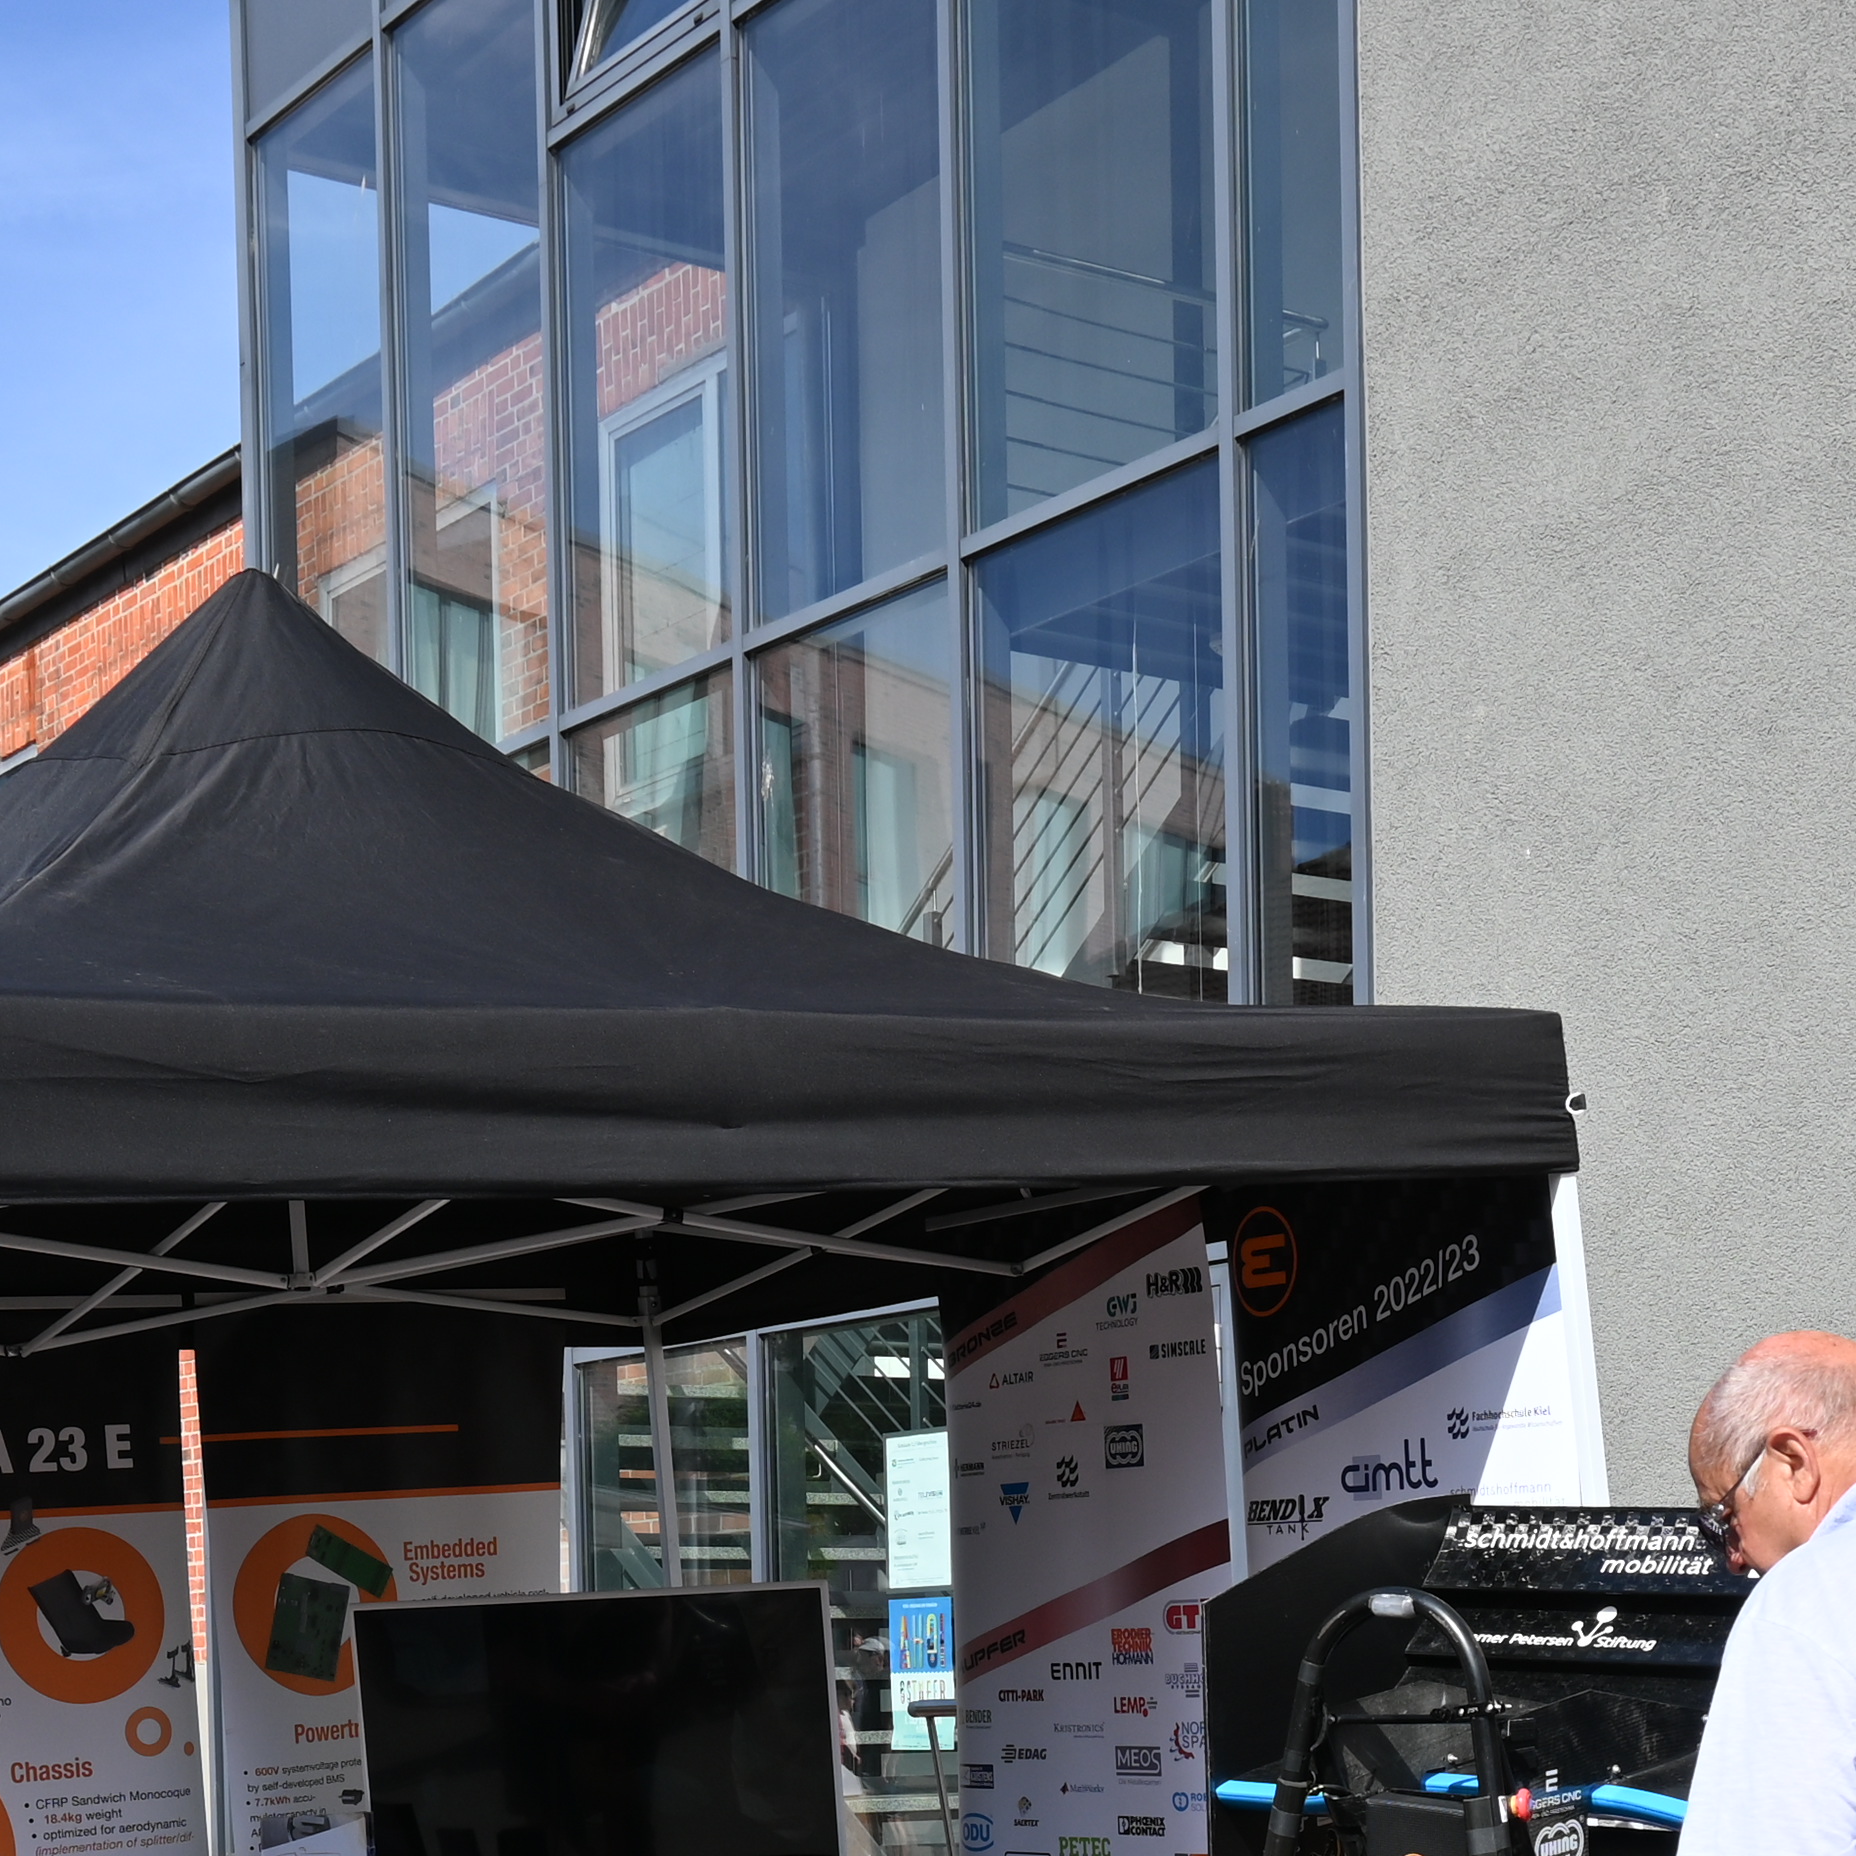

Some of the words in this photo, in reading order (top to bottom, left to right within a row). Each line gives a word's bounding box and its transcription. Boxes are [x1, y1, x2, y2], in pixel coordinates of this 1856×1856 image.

[1239, 1301, 1368, 1397] Sponsoren
[1373, 1233, 1480, 1323] 2022/23
[1096, 1318, 1138, 1331] TECHNOLOGY
[1161, 1339, 1206, 1358] SIMSCALE
[1002, 1372, 1034, 1386] ALTAIR
[1533, 1405, 1551, 1416] Kiel
[28, 1426, 87, 1473] 23
[105, 1424, 133, 1469] E
[992, 1440, 1030, 1451] STRIEZEL
[1341, 1437, 1439, 1493] cimtt
[1465, 1529, 1695, 1550] schmidt&hoffmann
[403, 1537, 498, 1562] Embedded
[409, 1560, 485, 1585] Systems
[1600, 1555, 1713, 1574] mobilität
[962, 1629, 1026, 1671] UPFER
[1509, 1634, 1574, 1646] Petersen
[1594, 1636, 1657, 1651] Stiftung
[999, 1689, 1044, 1702] CITTI-PARK
[965, 1710, 991, 1724] BENDER
[1018, 1749, 1046, 1760] EDAG
[1118, 1749, 1160, 1768] MEOS
[10, 1758, 93, 1784] Chassis
[255, 1767, 279, 1777] 600V
[247, 1783, 260, 1793] by
[262, 1776, 324, 1791] self-developed
[35, 1797, 69, 1810] CFRP
[71, 1792, 126, 1808] Sandwich
[130, 1787, 191, 1803] Monocoque
[44, 1810, 83, 1826] 18.4kg
[86, 1808, 122, 1822] weight
[43, 1827, 95, 1843] optimized
[99, 1824, 114, 1837] for
[117, 1817, 187, 1834] aerodynamic
[1130, 1826, 1165, 1837] CONTACT
[126, 1835, 139, 1847] of
